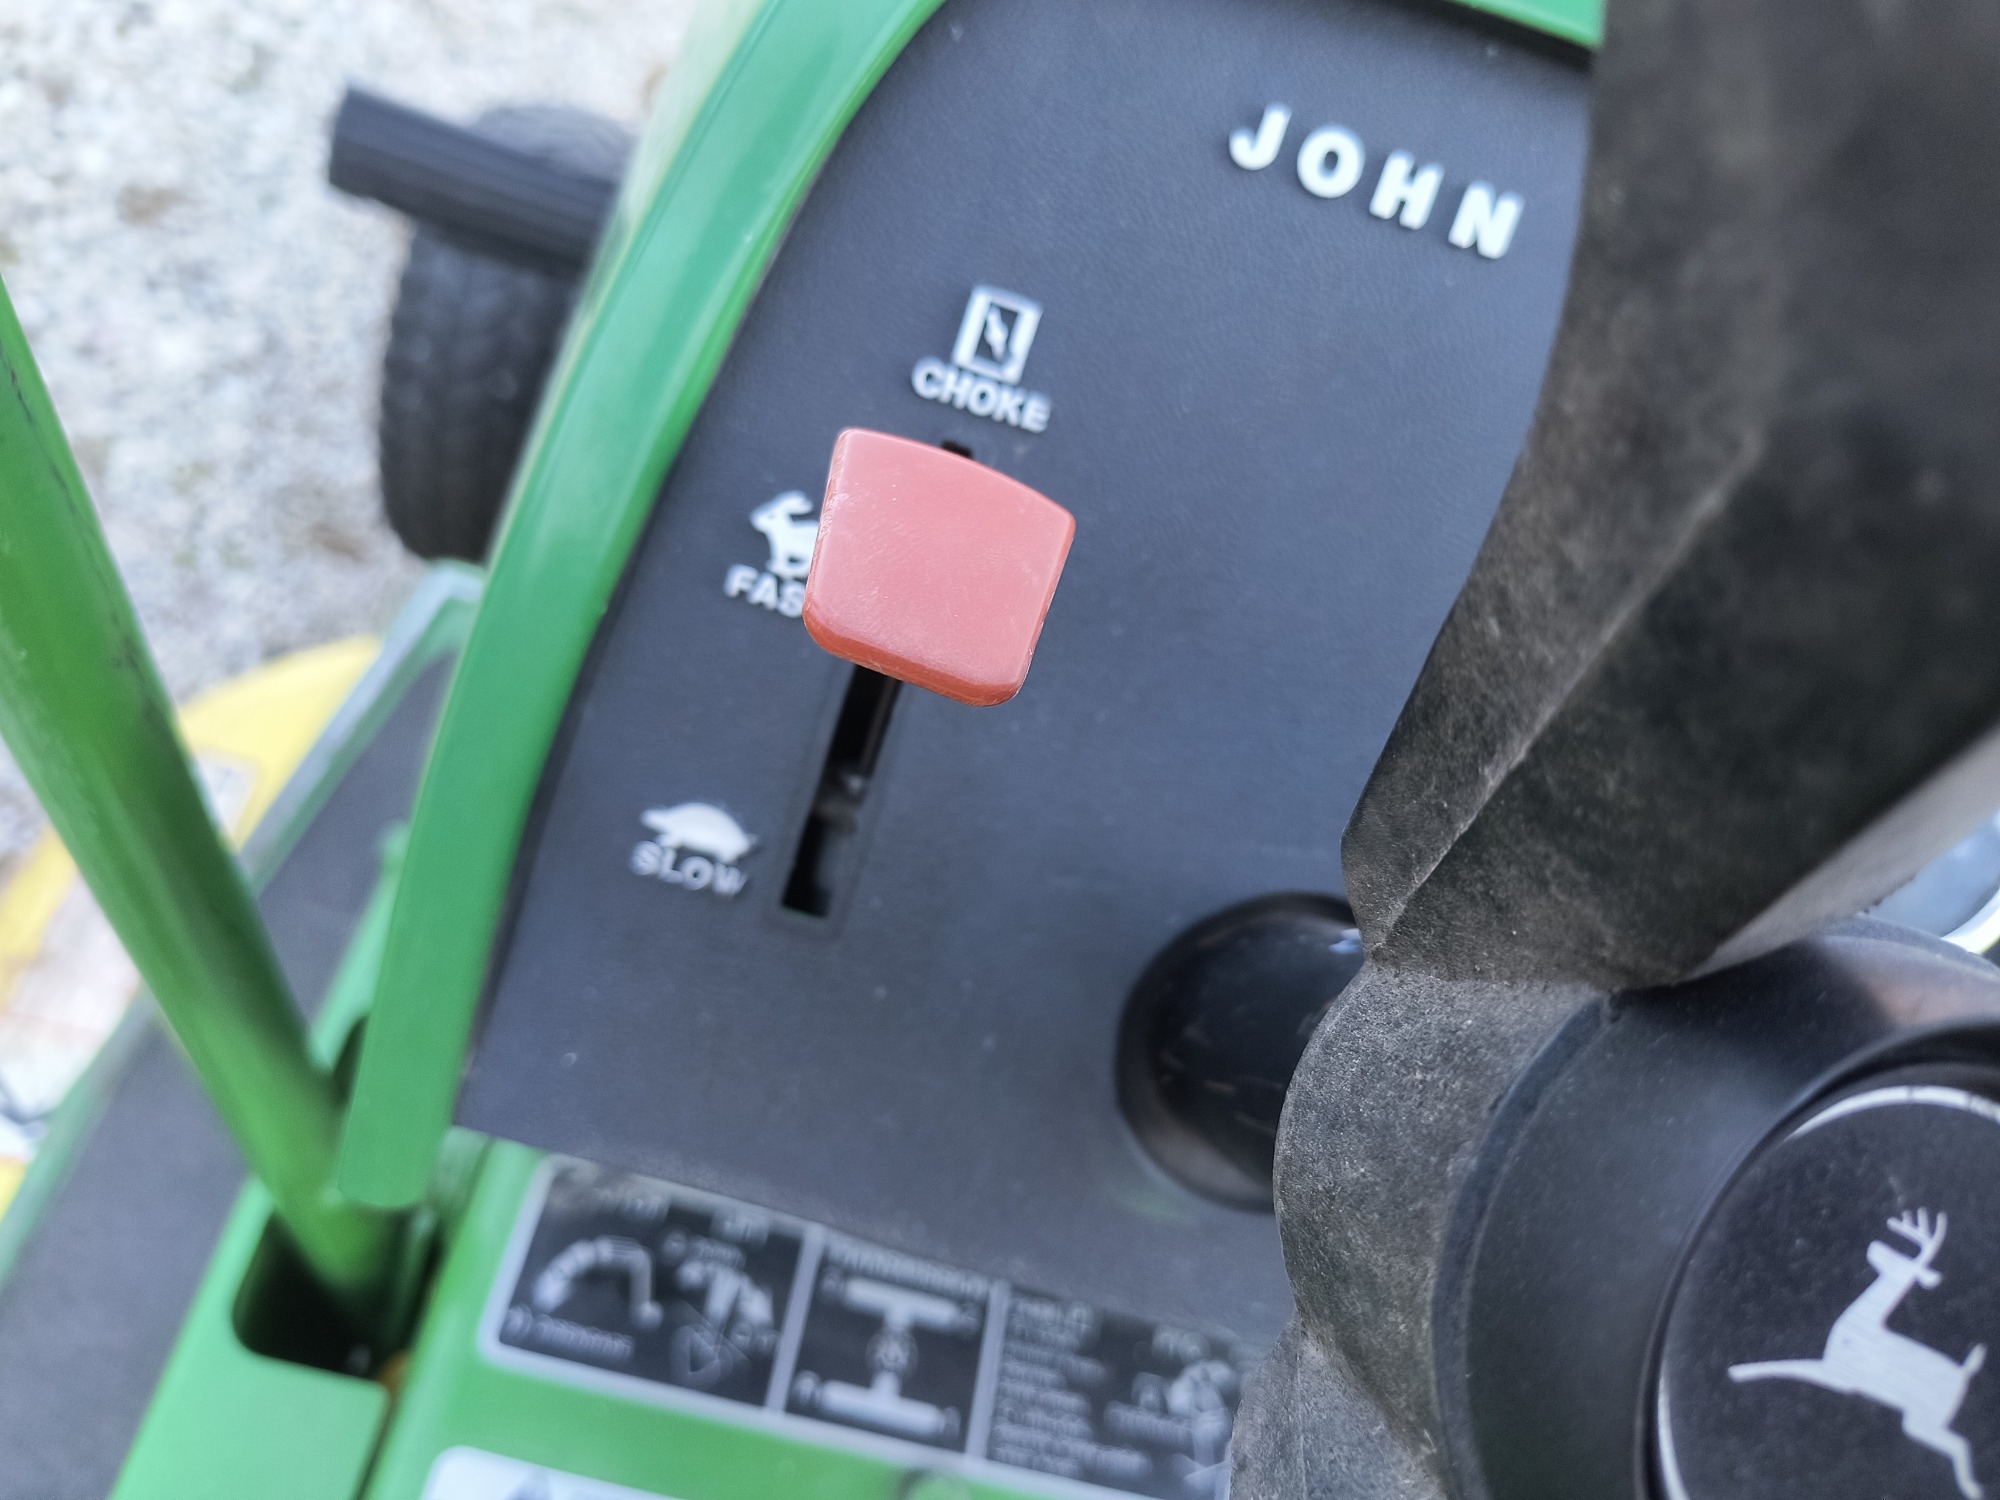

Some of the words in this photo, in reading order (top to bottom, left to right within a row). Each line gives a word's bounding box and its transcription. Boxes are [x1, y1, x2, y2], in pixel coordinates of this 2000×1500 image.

[1229, 102, 1525, 259] JOHN
[911, 358, 1051, 433] CHOKE
[724, 563, 806, 619] FAS
[631, 840, 747, 896] SLOW
